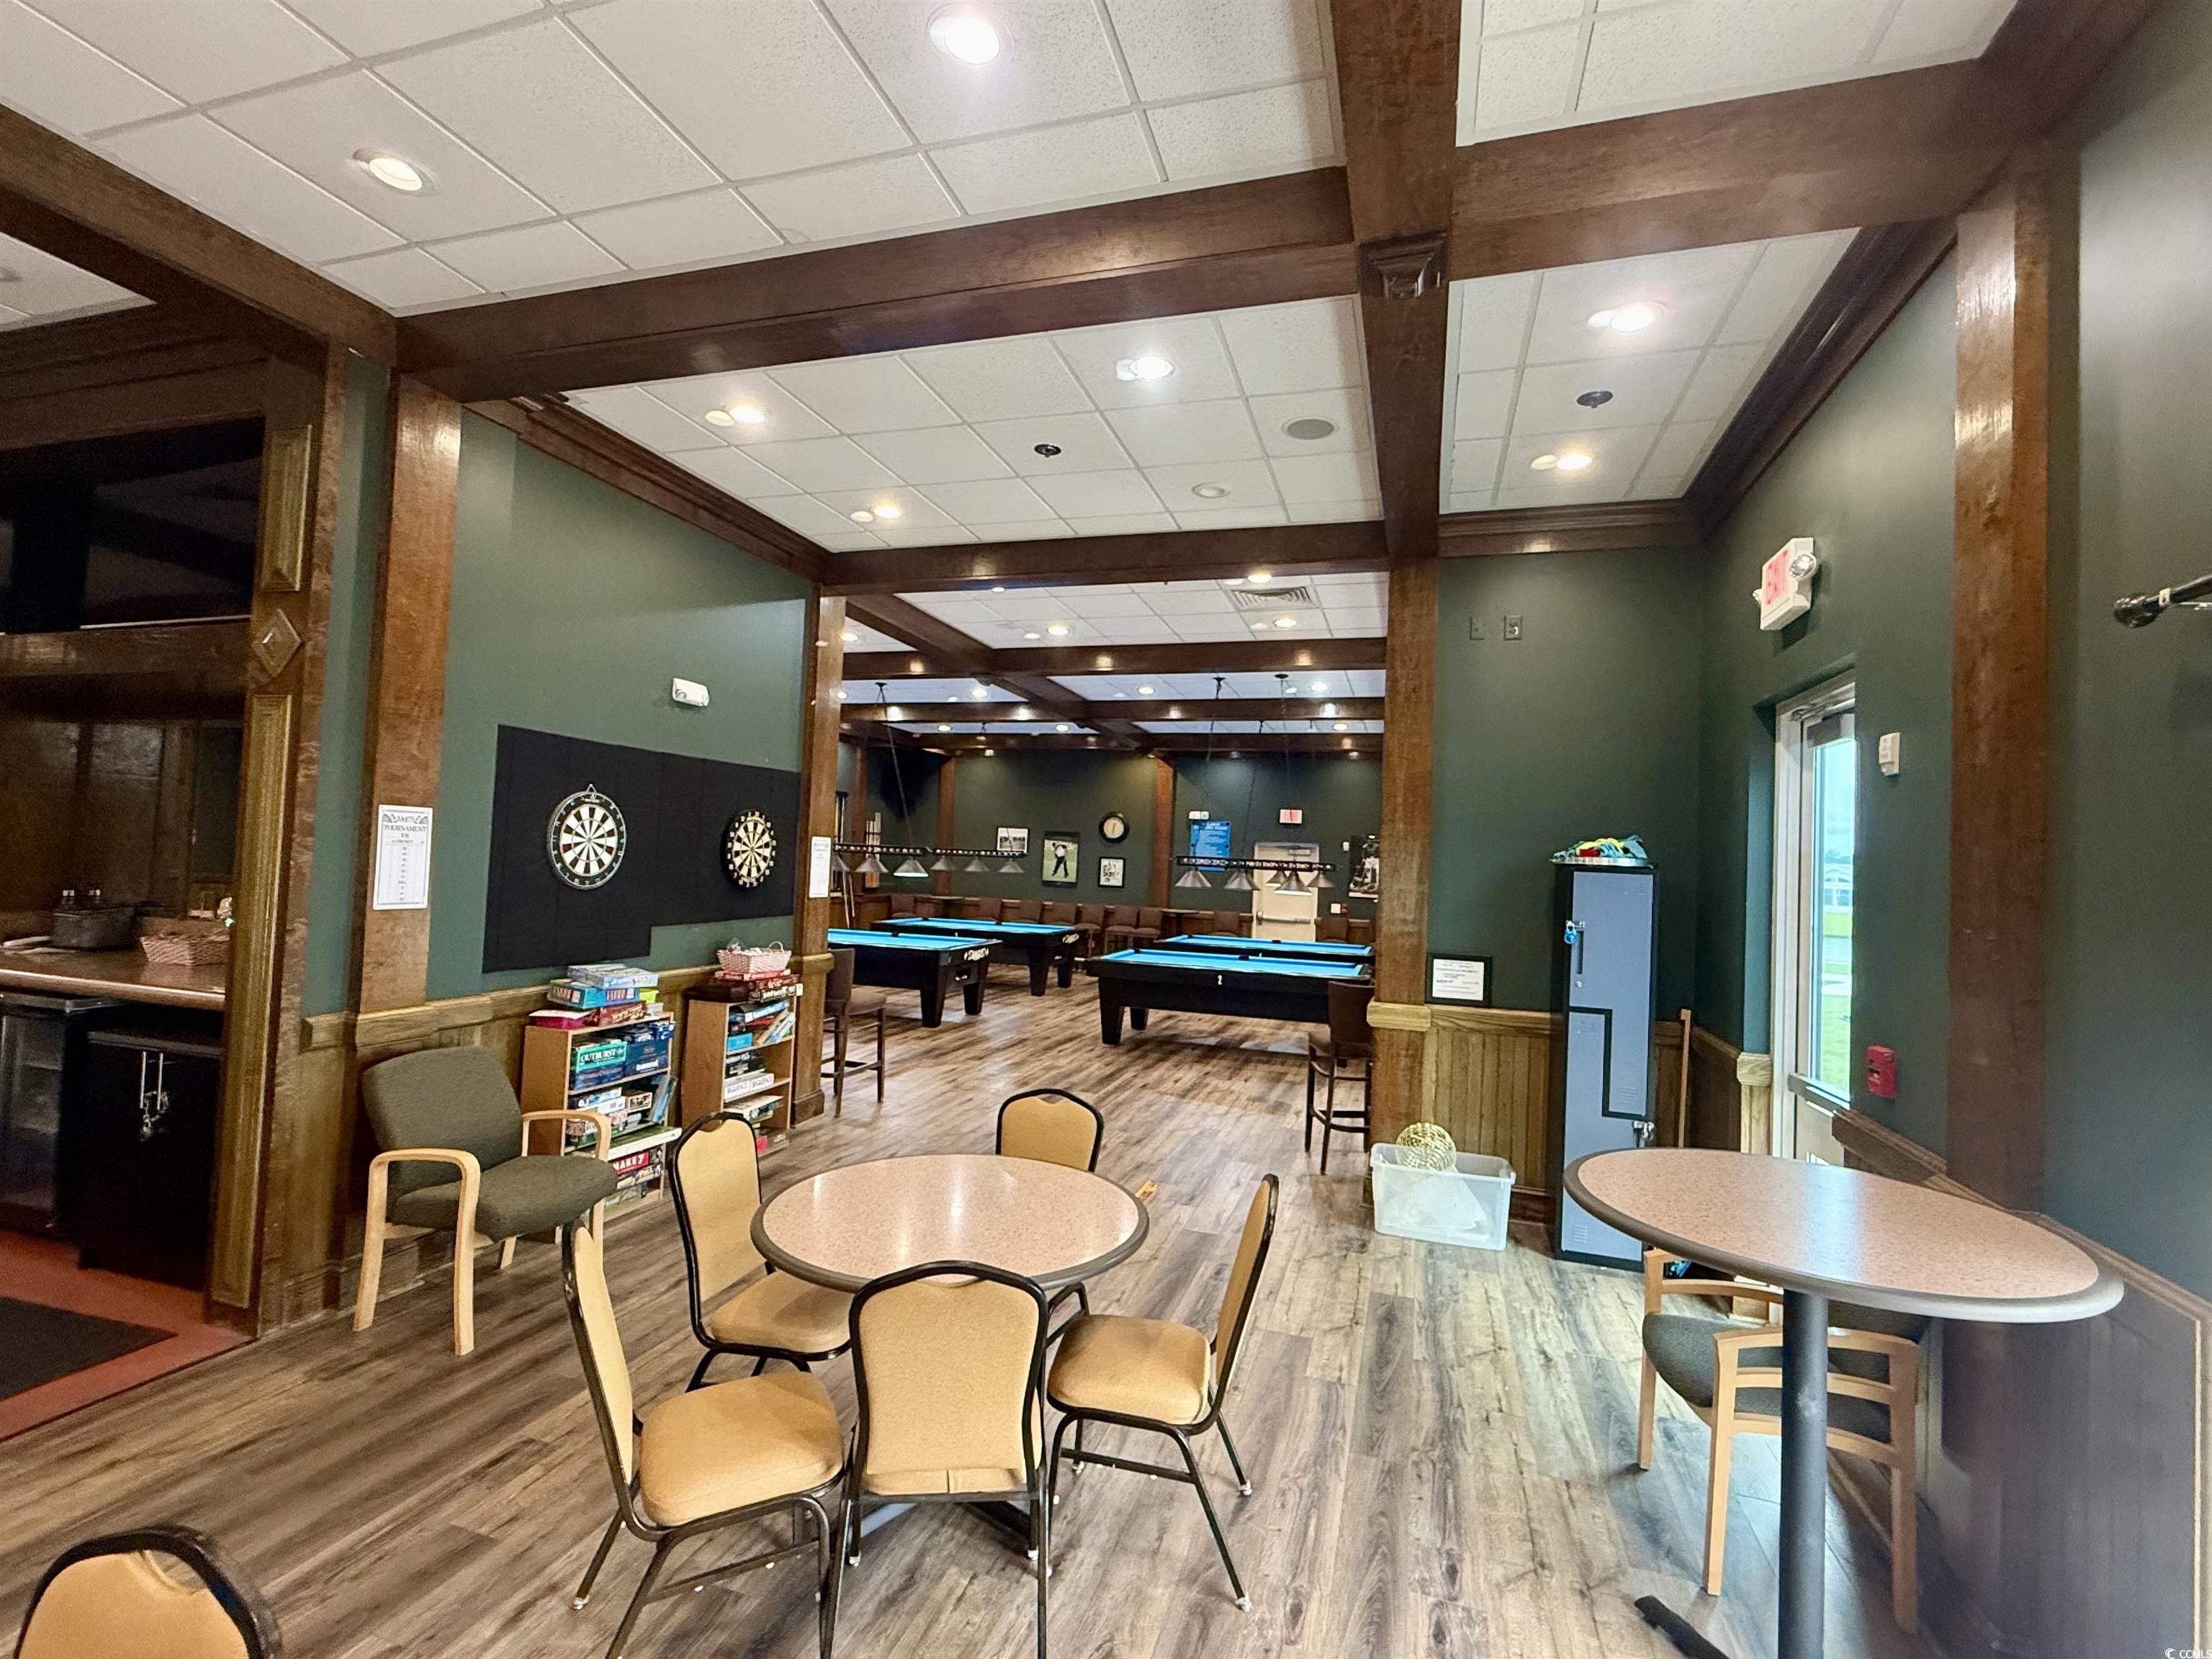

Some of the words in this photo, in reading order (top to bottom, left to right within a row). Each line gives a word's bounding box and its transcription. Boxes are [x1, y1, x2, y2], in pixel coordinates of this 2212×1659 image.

[580, 1048, 617, 1062] OUTBURST
[613, 1156, 637, 1170] MAKE
[638, 1154, 645, 1164] 7
